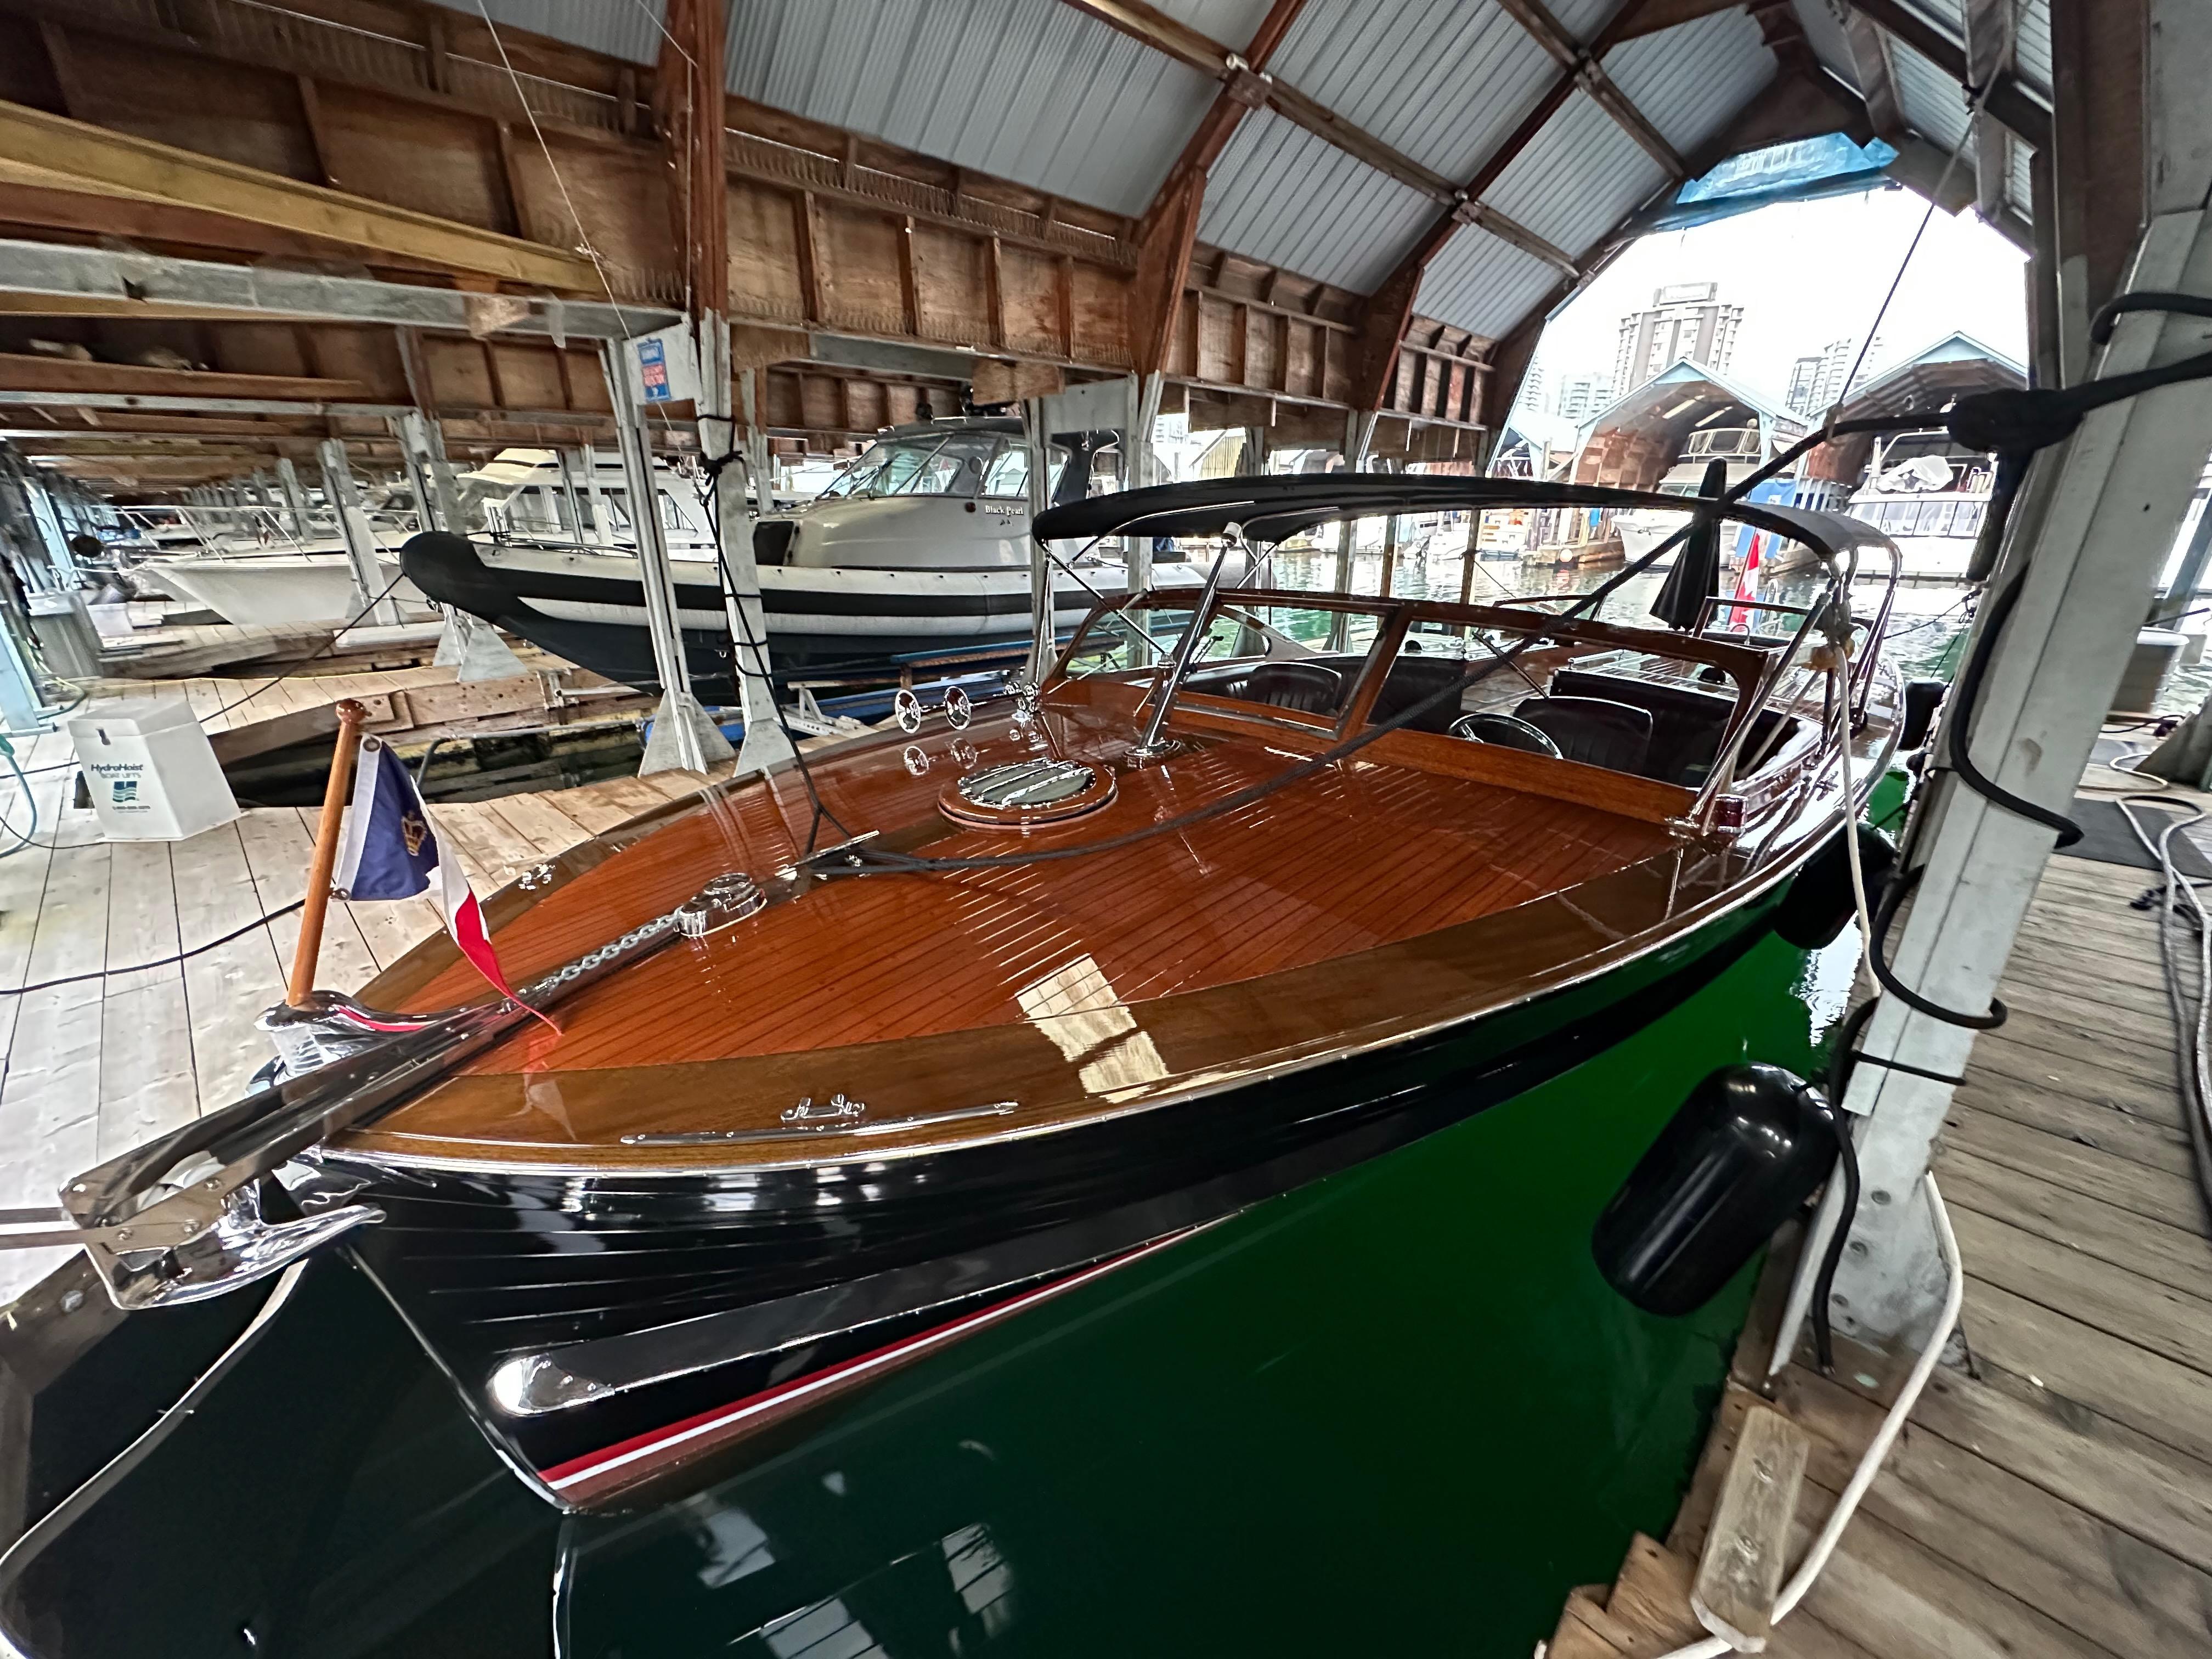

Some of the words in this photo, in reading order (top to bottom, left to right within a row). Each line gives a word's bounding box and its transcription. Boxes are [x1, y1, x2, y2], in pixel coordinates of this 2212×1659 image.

[985, 505, 1005, 514] Black
[1006, 506, 1024, 516] Pearl
[91, 764, 143, 773] HydroHoist
